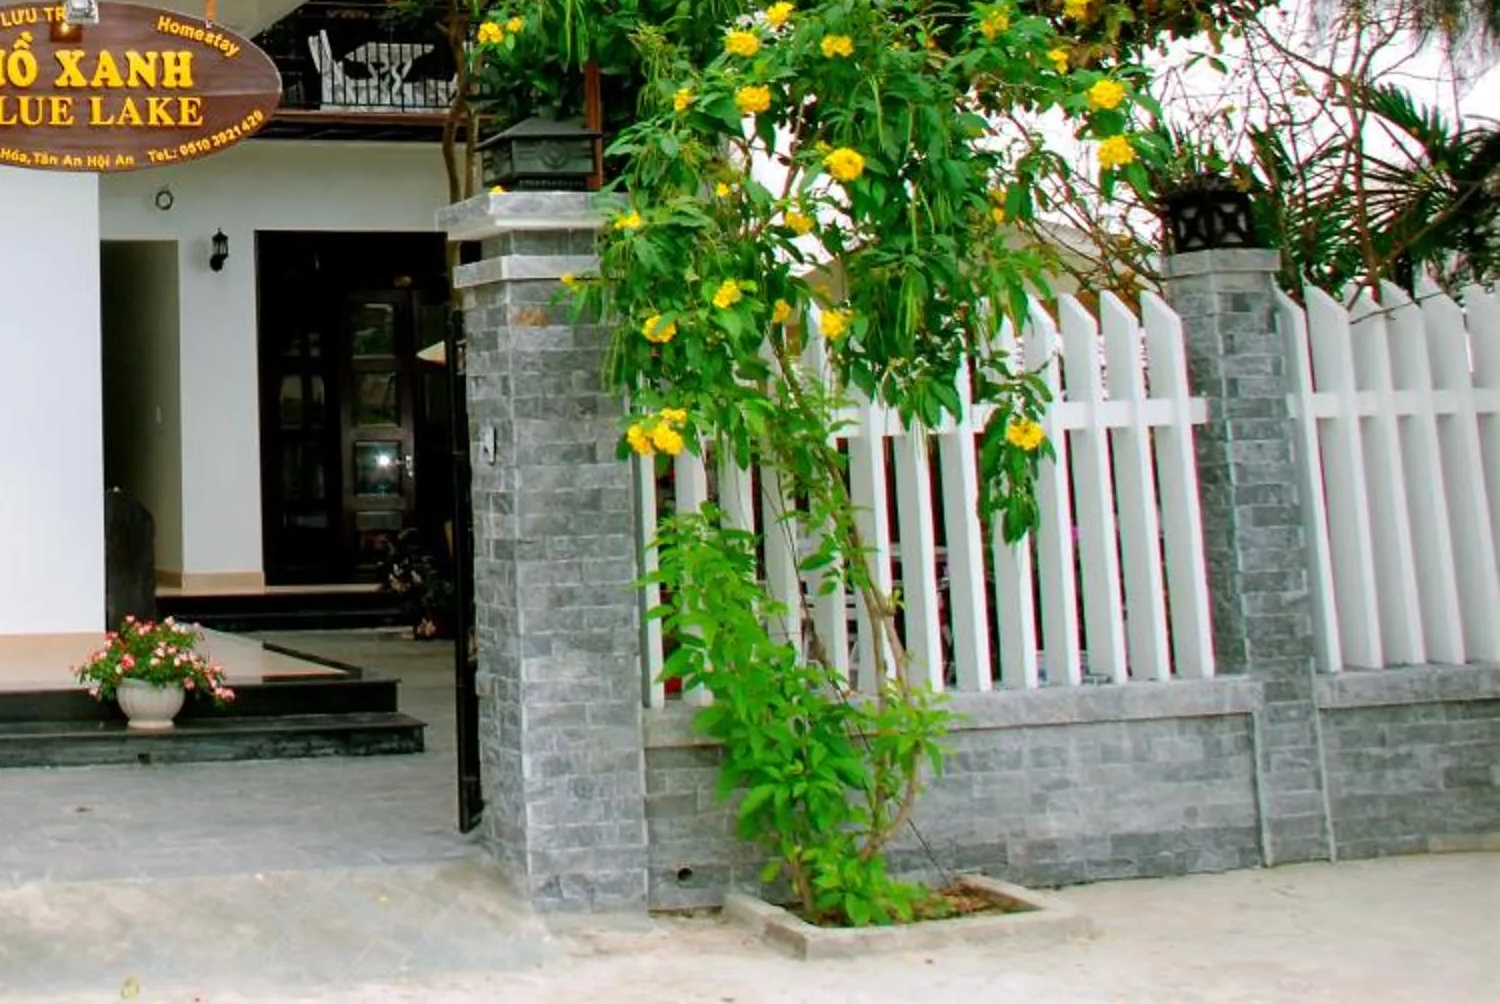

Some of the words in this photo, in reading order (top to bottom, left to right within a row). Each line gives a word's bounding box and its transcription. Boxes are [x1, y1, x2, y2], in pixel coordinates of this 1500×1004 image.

[1, 7, 37, 27] LƯU
[44, 5, 69, 22] TR
[157, 15, 241, 58] Homestay
[54, 50, 194, 88] XANH
[89, 96, 203, 126] LAKE
[63, 154, 83, 167] An
[115, 154, 135, 167] An
